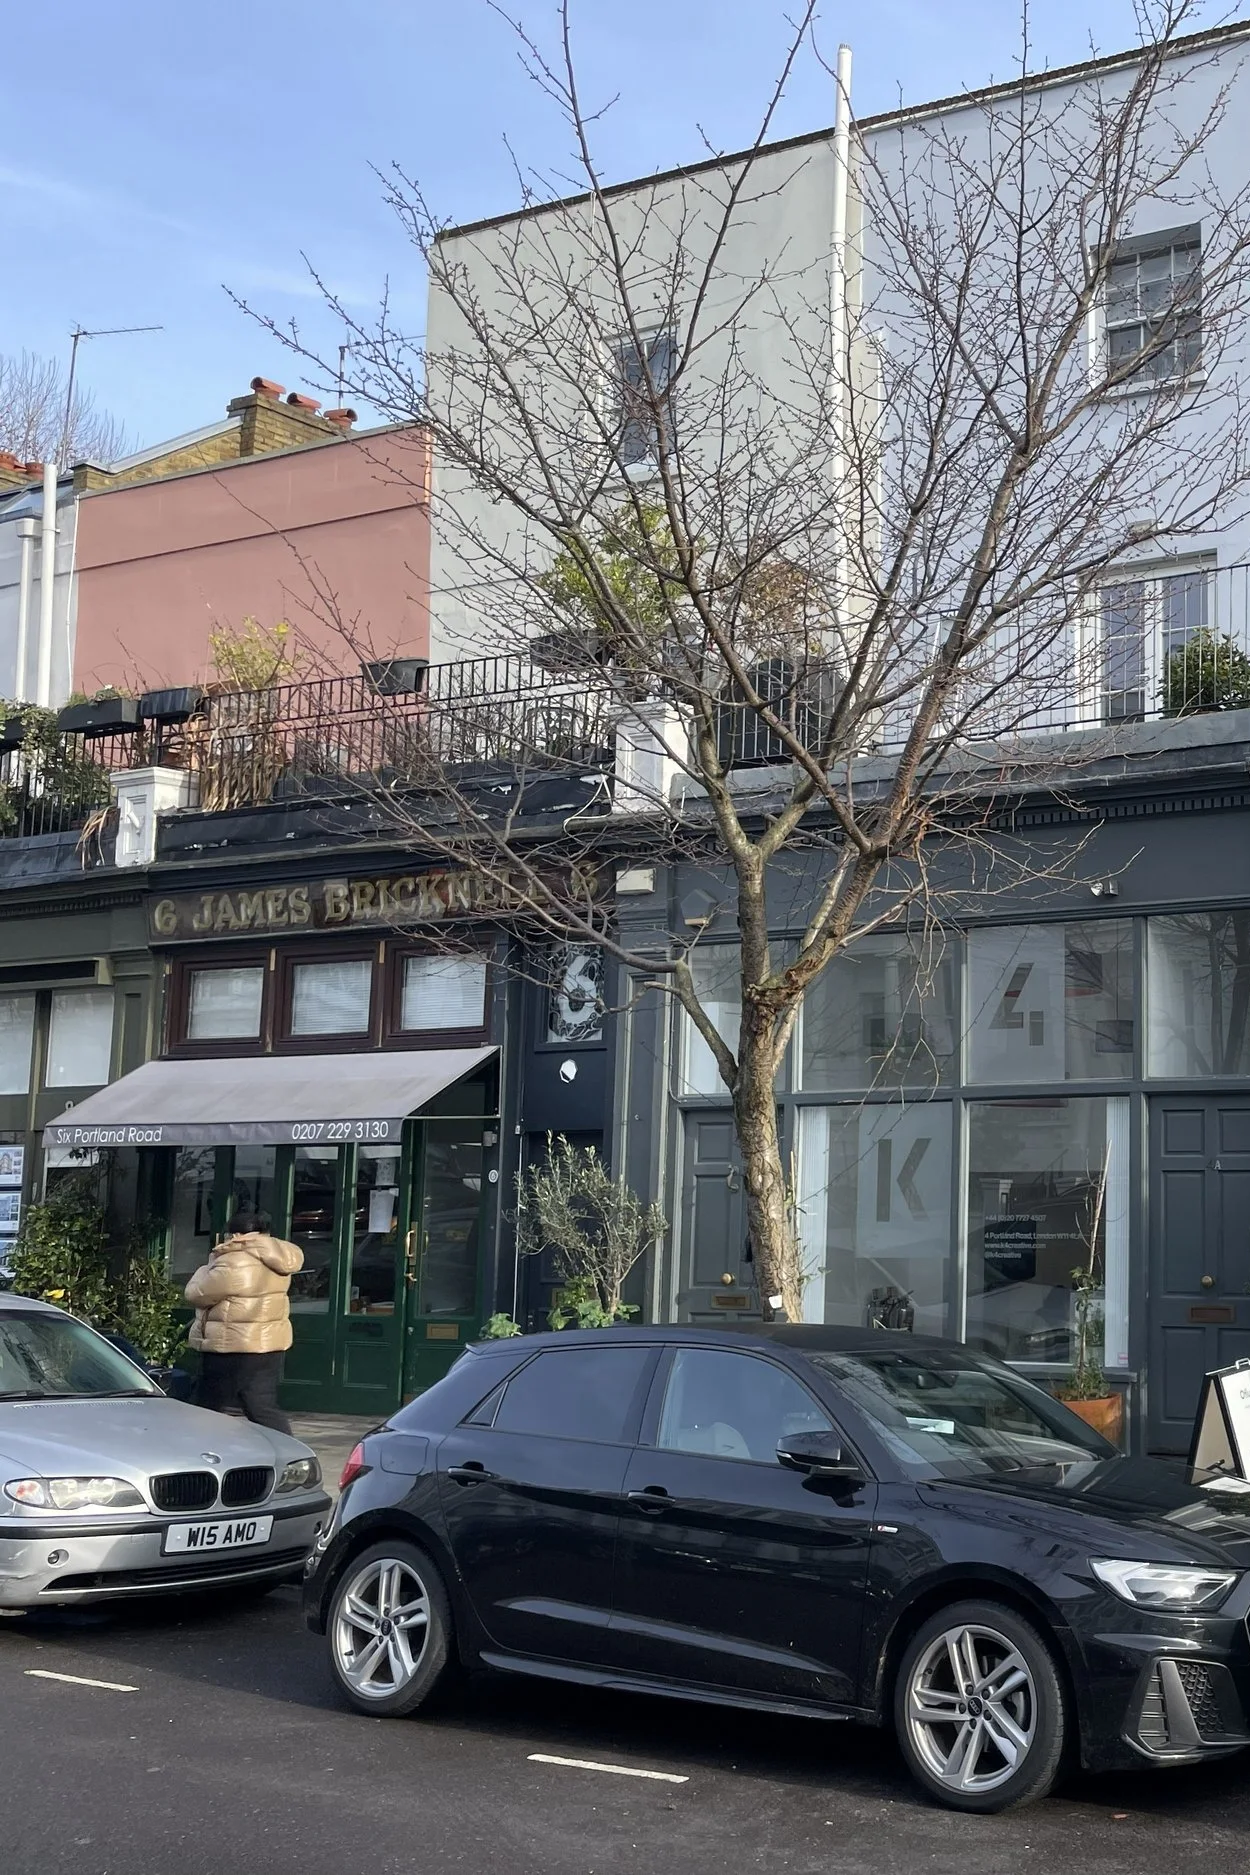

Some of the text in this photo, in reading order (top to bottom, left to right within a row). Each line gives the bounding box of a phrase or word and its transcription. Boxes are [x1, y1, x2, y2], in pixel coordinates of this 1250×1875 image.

[193, 886, 312, 932] JAMES
[988, 962, 1044, 1046] 4
[56, 1127, 163, 1144] Six Portland Road
[291, 1121, 389, 1140] 0207 229 3130
[876, 1138, 932, 1222] K
[222, 1522, 257, 1544] AMO
